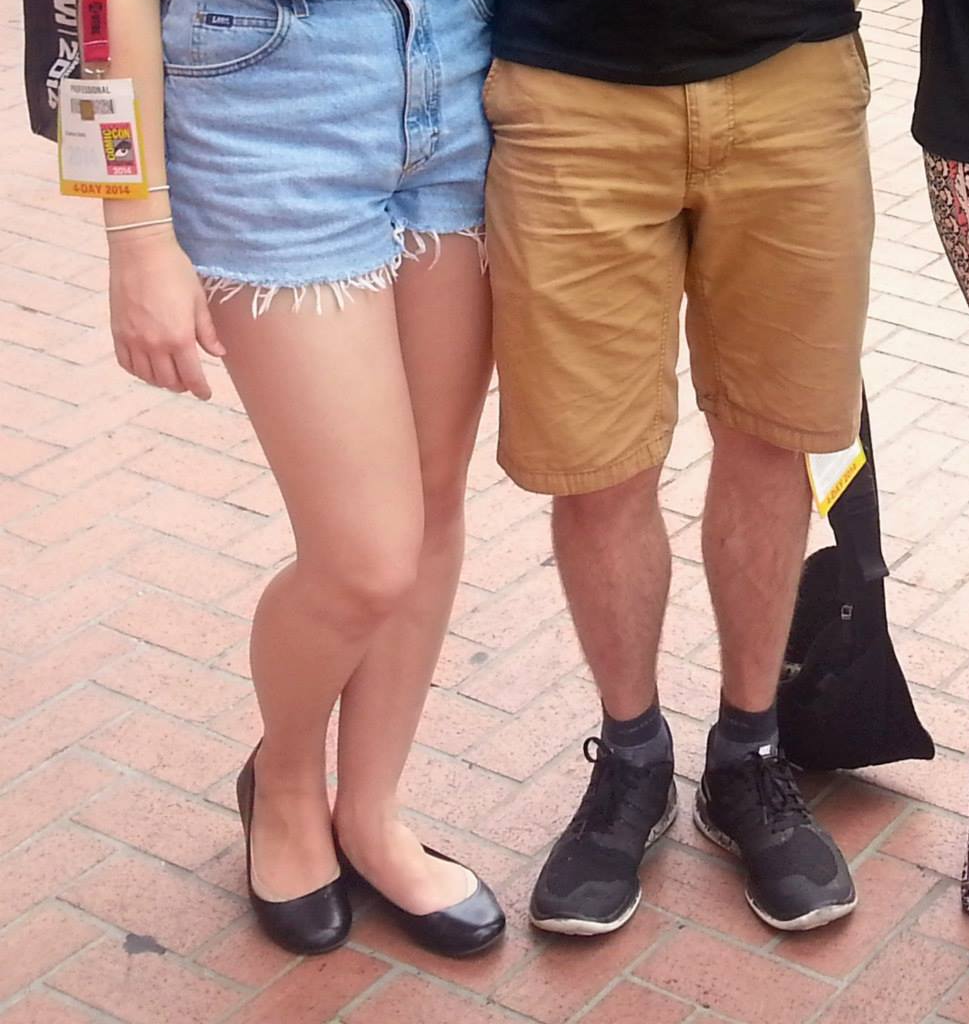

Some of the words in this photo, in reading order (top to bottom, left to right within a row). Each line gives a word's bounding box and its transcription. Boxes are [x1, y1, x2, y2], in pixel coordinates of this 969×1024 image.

[111, 127, 131, 140] CON
[103, 129, 116, 161] COMIC
[105, 182, 130, 195] 2014
